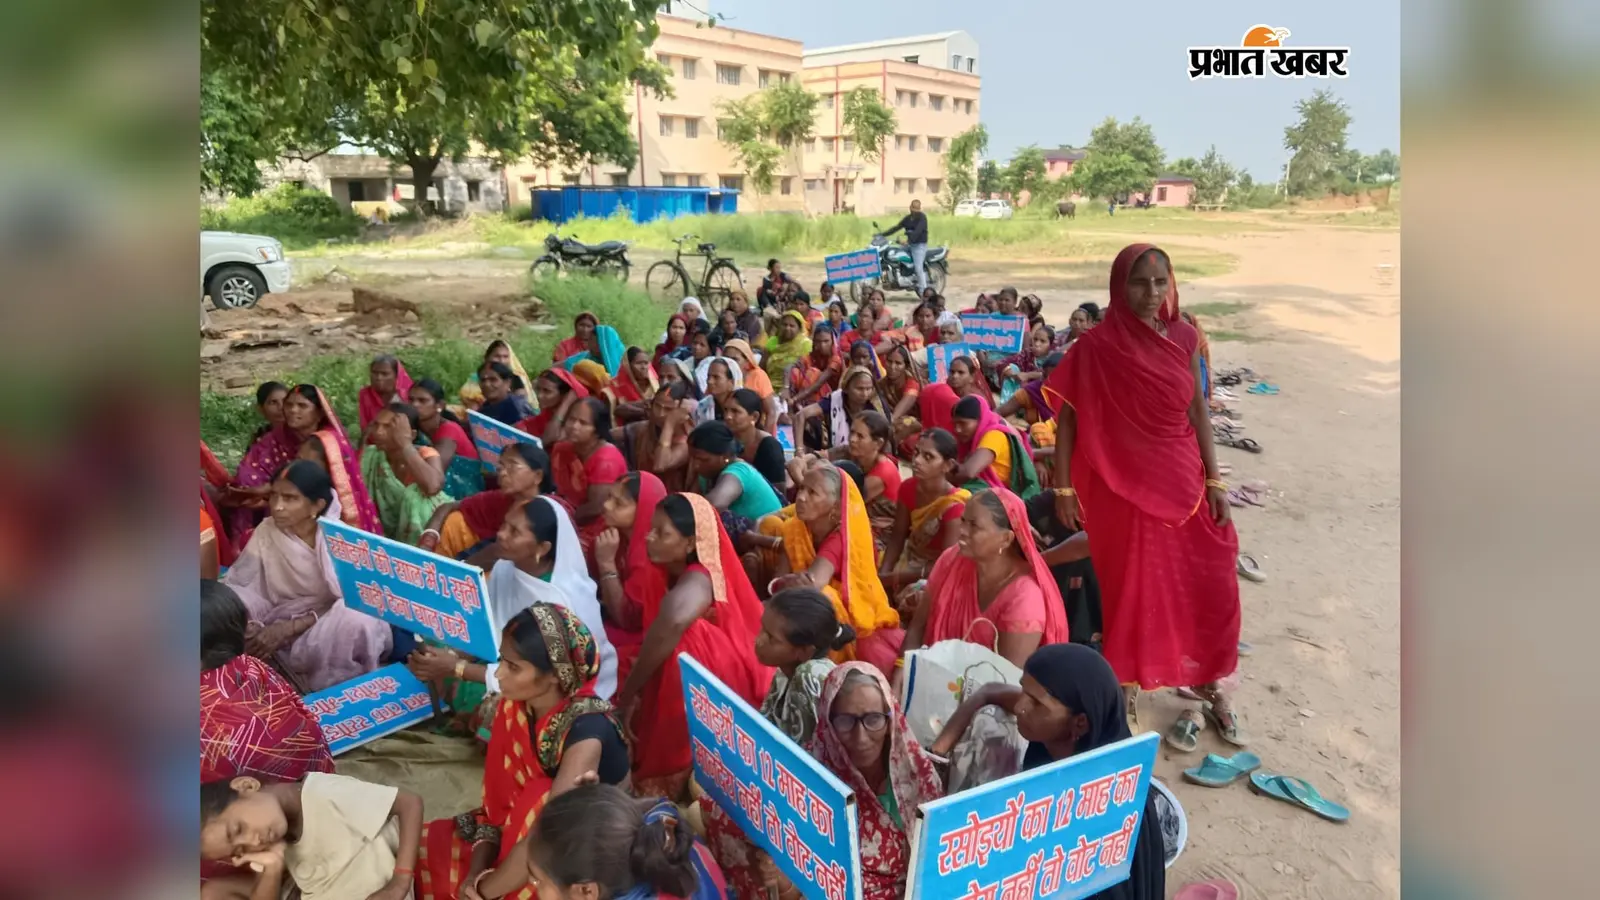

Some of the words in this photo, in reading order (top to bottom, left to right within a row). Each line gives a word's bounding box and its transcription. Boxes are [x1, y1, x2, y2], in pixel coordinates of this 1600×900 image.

[372, 546, 394, 578] को
[392, 558, 424, 588] साल
[439, 573, 451, 598] 2
[370, 702, 408, 725] तक
[689, 683, 736, 753] रसोइयों
[735, 726, 758, 774] का
[759, 748, 776, 791] 12
[775, 760, 808, 821] माह
[808, 789, 835, 846] का
[736, 782, 764, 833] नहीं
[764, 800, 783, 853] तो
[783, 819, 814, 881] वोट
[938, 791, 1026, 877] रसोइयों
[1021, 794, 1055, 842] का
[1053, 788, 1076, 832] 12
[1076, 773, 1115, 820] माह
[1113, 764, 1143, 807] का
[1040, 844, 1067, 898] तो
[1065, 835, 1100, 884] वोट
[1099, 811, 1138, 870] नहीं
